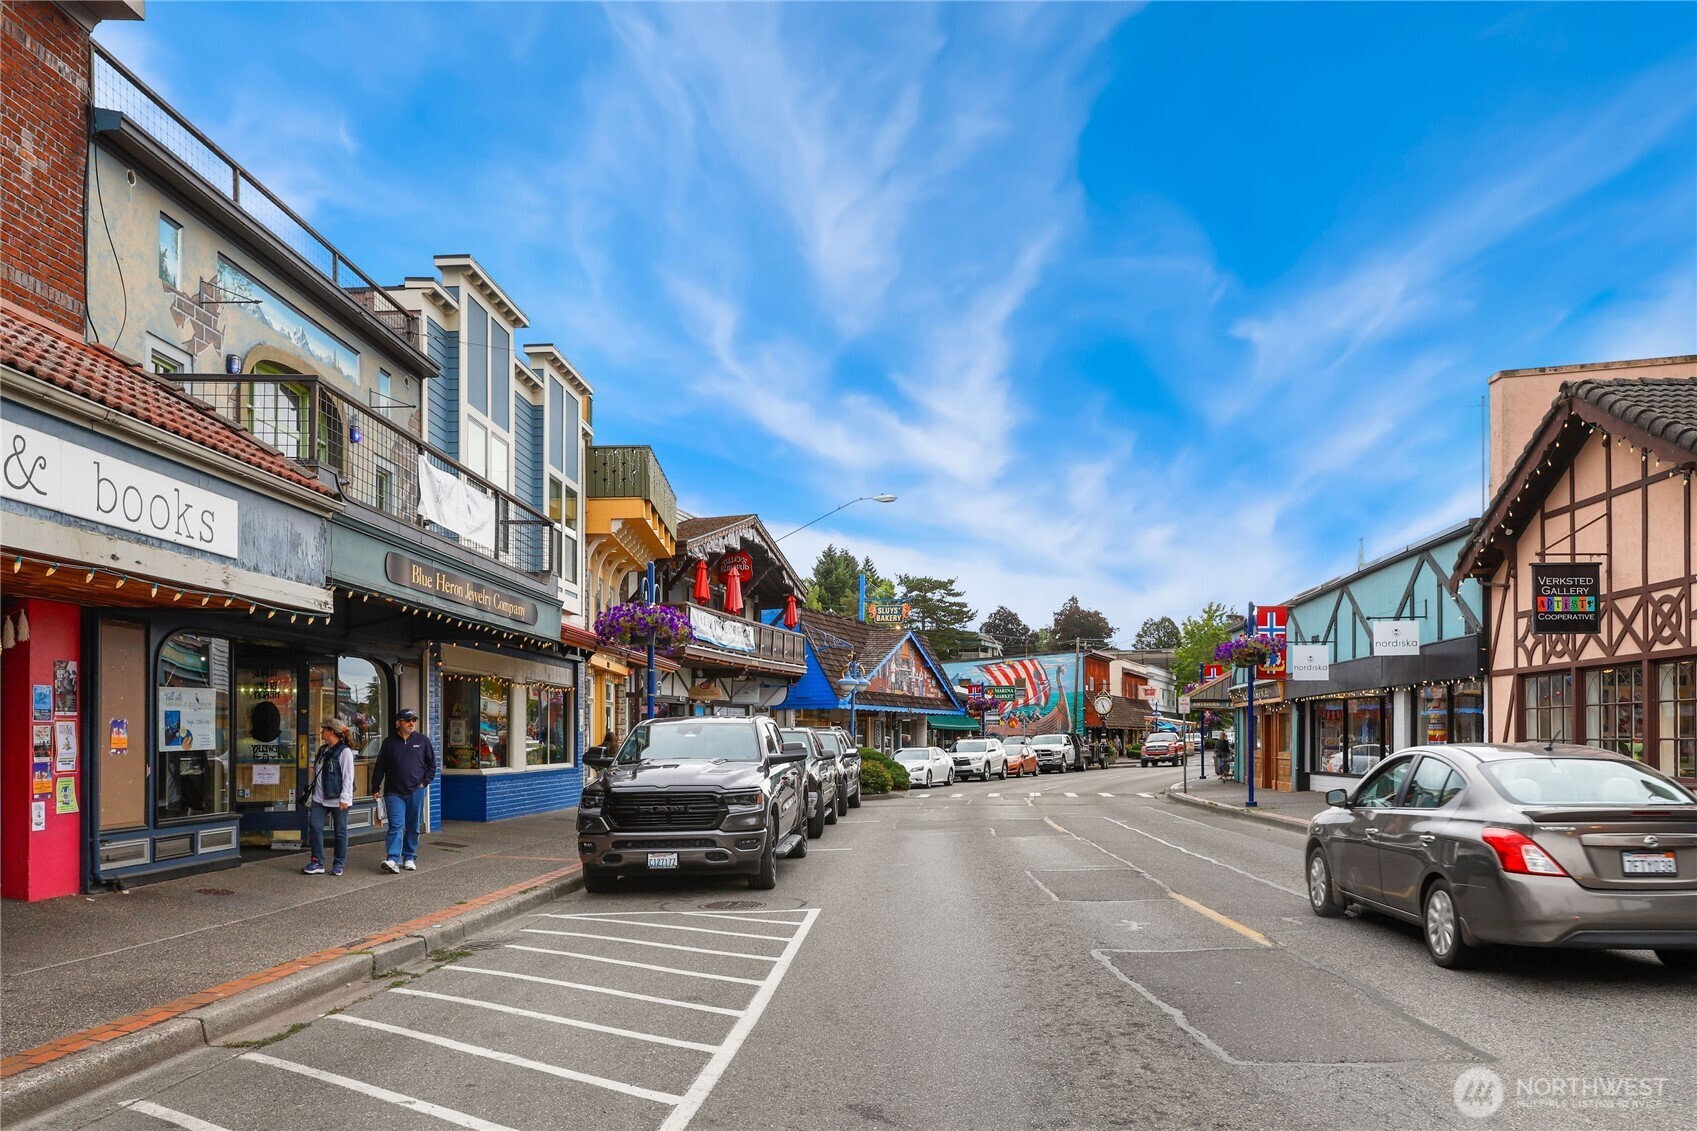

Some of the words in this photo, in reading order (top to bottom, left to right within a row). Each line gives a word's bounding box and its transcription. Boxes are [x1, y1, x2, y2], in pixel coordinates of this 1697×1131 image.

[3, 434, 48, 496] &
[93, 460, 216, 544] books
[1537, 576, 1594, 585] VERKSTED
[411, 563, 433, 588] Blue
[436, 572, 464, 597] Heron
[464, 582, 492, 610] Jewelry
[493, 592, 527, 620] Company
[1541, 586, 1590, 595] GALLERY
[877, 607, 901, 615] SLUYS'
[876, 614, 902, 622] BAKERY
[1537, 613, 1595, 621] COOPERATIVE
[1375, 639, 1418, 648] nordiska
[639, 804, 685, 814] RAM
